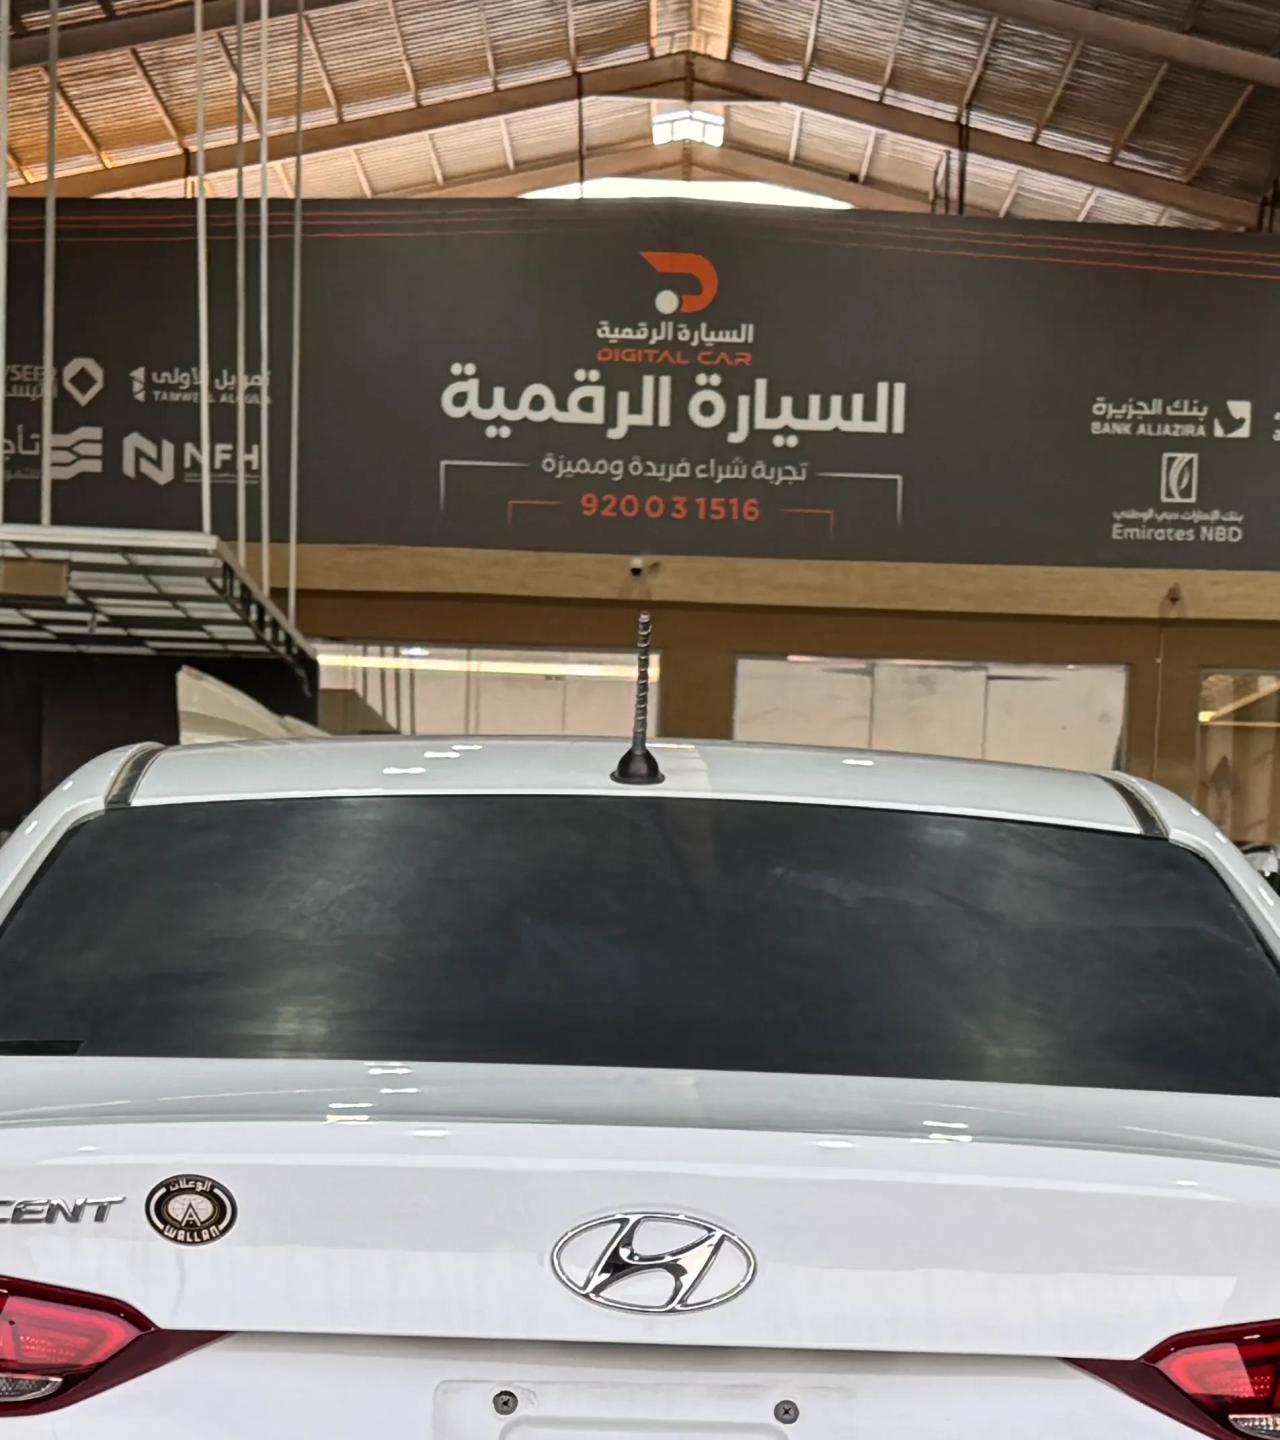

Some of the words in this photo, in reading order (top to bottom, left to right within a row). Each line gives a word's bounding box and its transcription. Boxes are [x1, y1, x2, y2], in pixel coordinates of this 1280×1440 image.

[596, 320, 674, 345] الرقمية
[677, 322, 753, 346] السيارة
[596, 348, 690, 365] DIGITAL
[697, 351, 752, 366] CAR
[440, 362, 672, 440] الرقمية
[687, 372, 907, 449] السيارة
[1091, 396, 1163, 421] الجزيرة
[1166, 398, 1209, 422] بنك
[1090, 420, 1133, 436] BANK
[541, 452, 624, 483] ومميزة
[628, 455, 691, 483] فريدة
[694, 456, 748, 482] شراء
[750, 459, 807, 486] تجربة
[1111, 522, 1197, 543] Emirates
[1199, 525, 1244, 544] NBD
[163, 1224, 221, 1243] WALLAN
